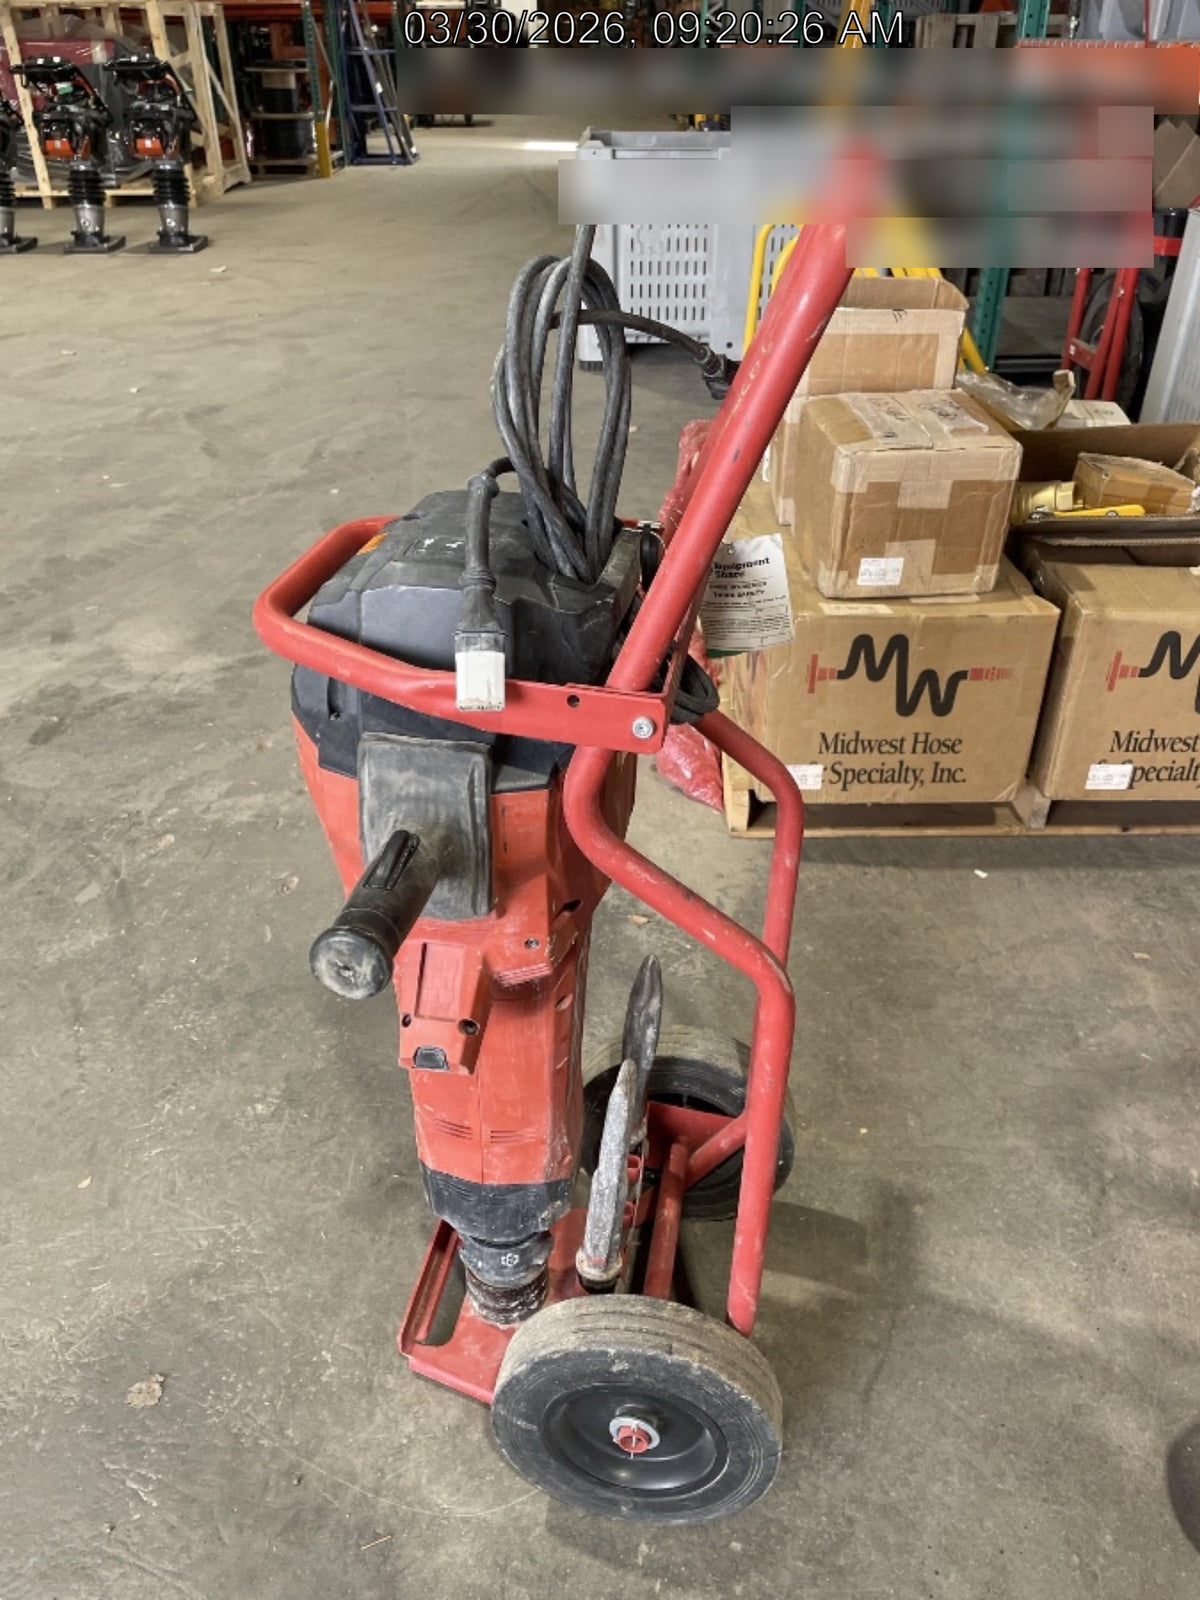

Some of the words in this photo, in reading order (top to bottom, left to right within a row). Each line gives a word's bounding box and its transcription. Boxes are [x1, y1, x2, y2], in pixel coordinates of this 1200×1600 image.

[818, 731, 905, 755] Midwest
[908, 732, 963, 755] Hose
[1109, 728, 1200, 753] Midwest
[828, 760, 924, 792] Specialty,
[931, 761, 966, 784] Inc.
